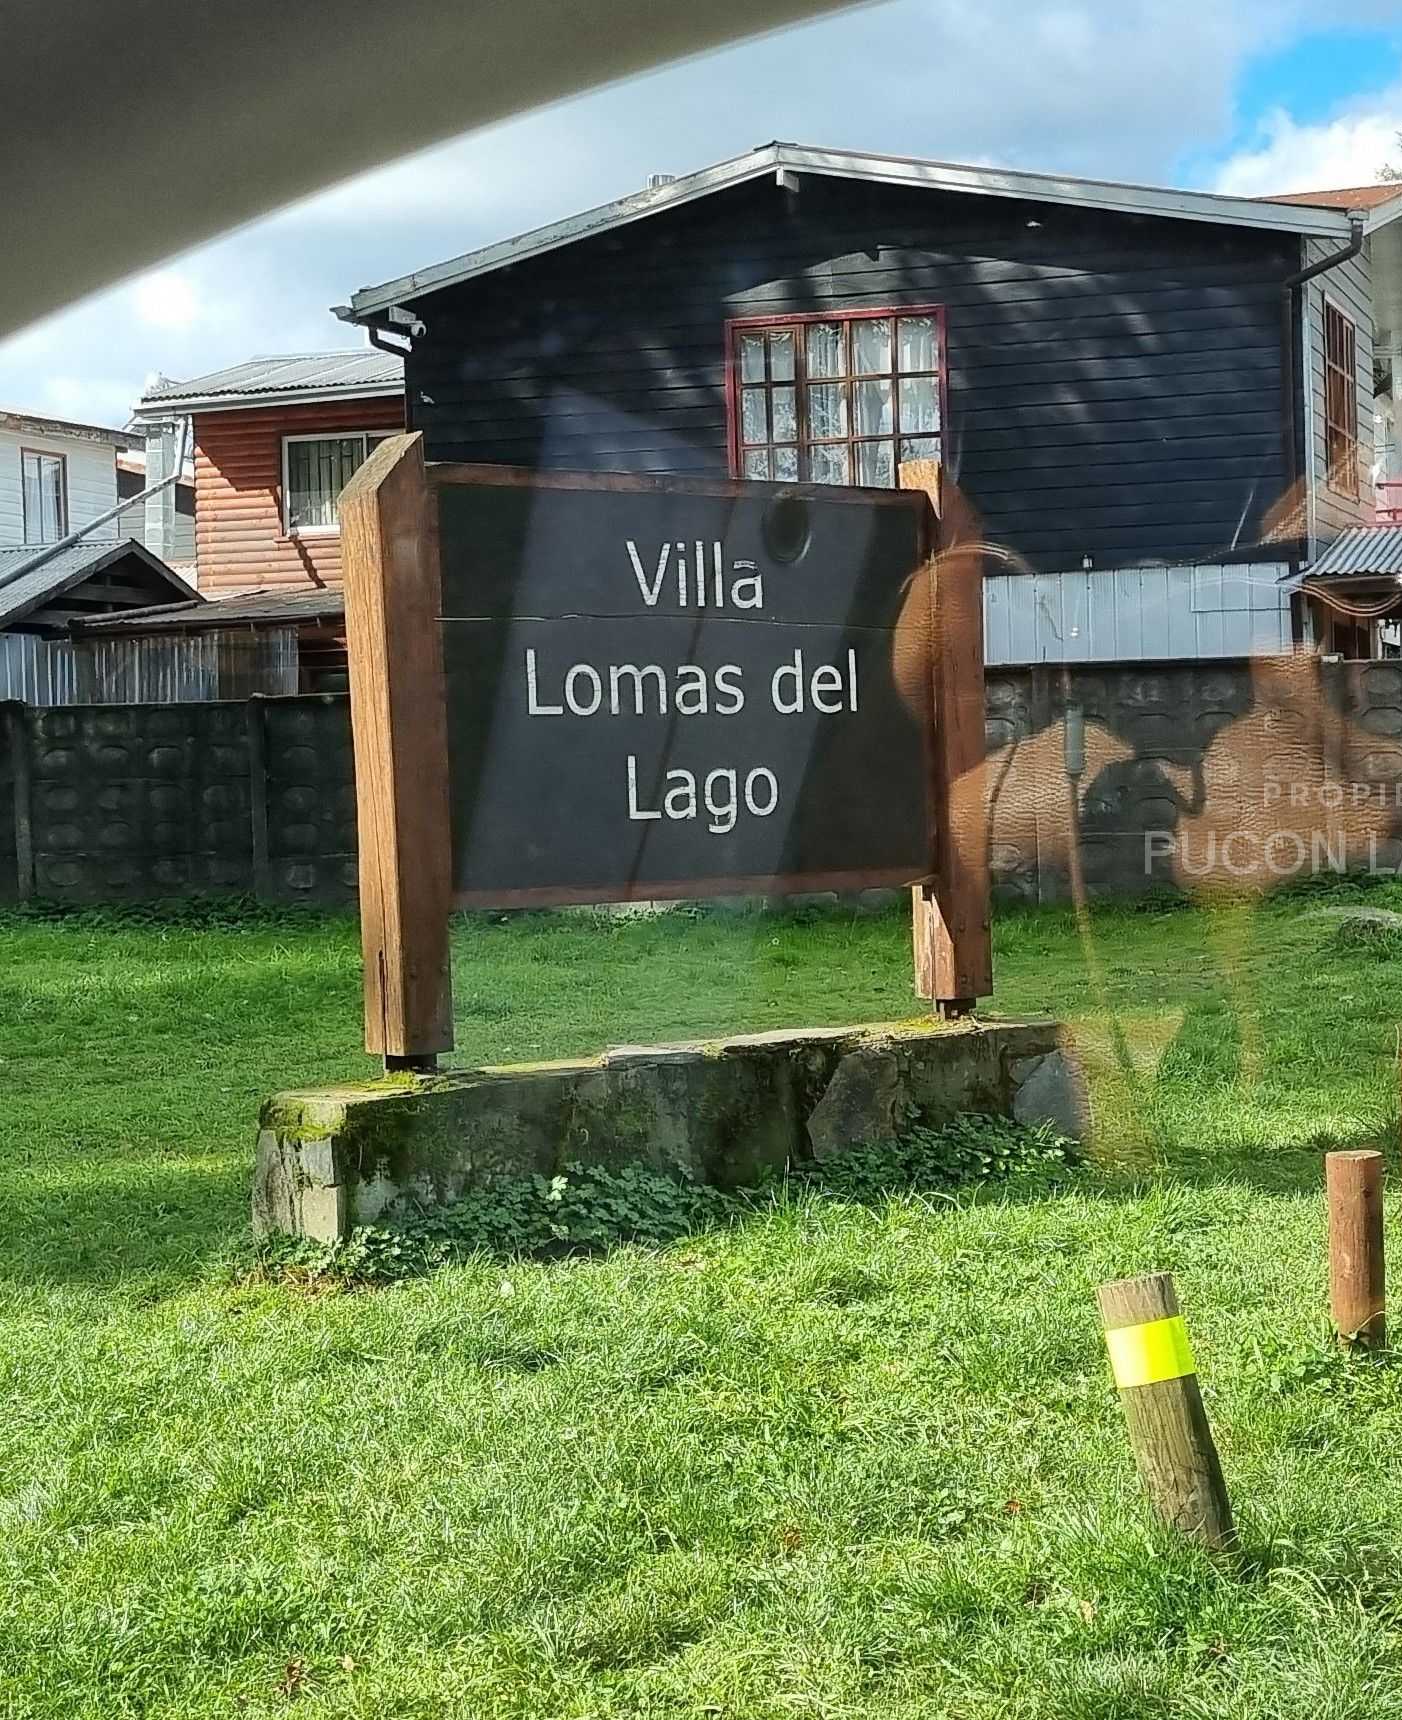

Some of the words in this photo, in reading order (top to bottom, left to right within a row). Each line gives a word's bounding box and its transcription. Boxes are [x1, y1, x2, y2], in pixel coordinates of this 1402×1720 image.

[625, 540, 764, 609] Villa
[526, 648, 745, 716] Lomas
[771, 648, 858, 714] del
[626, 755, 779, 834] Lago
